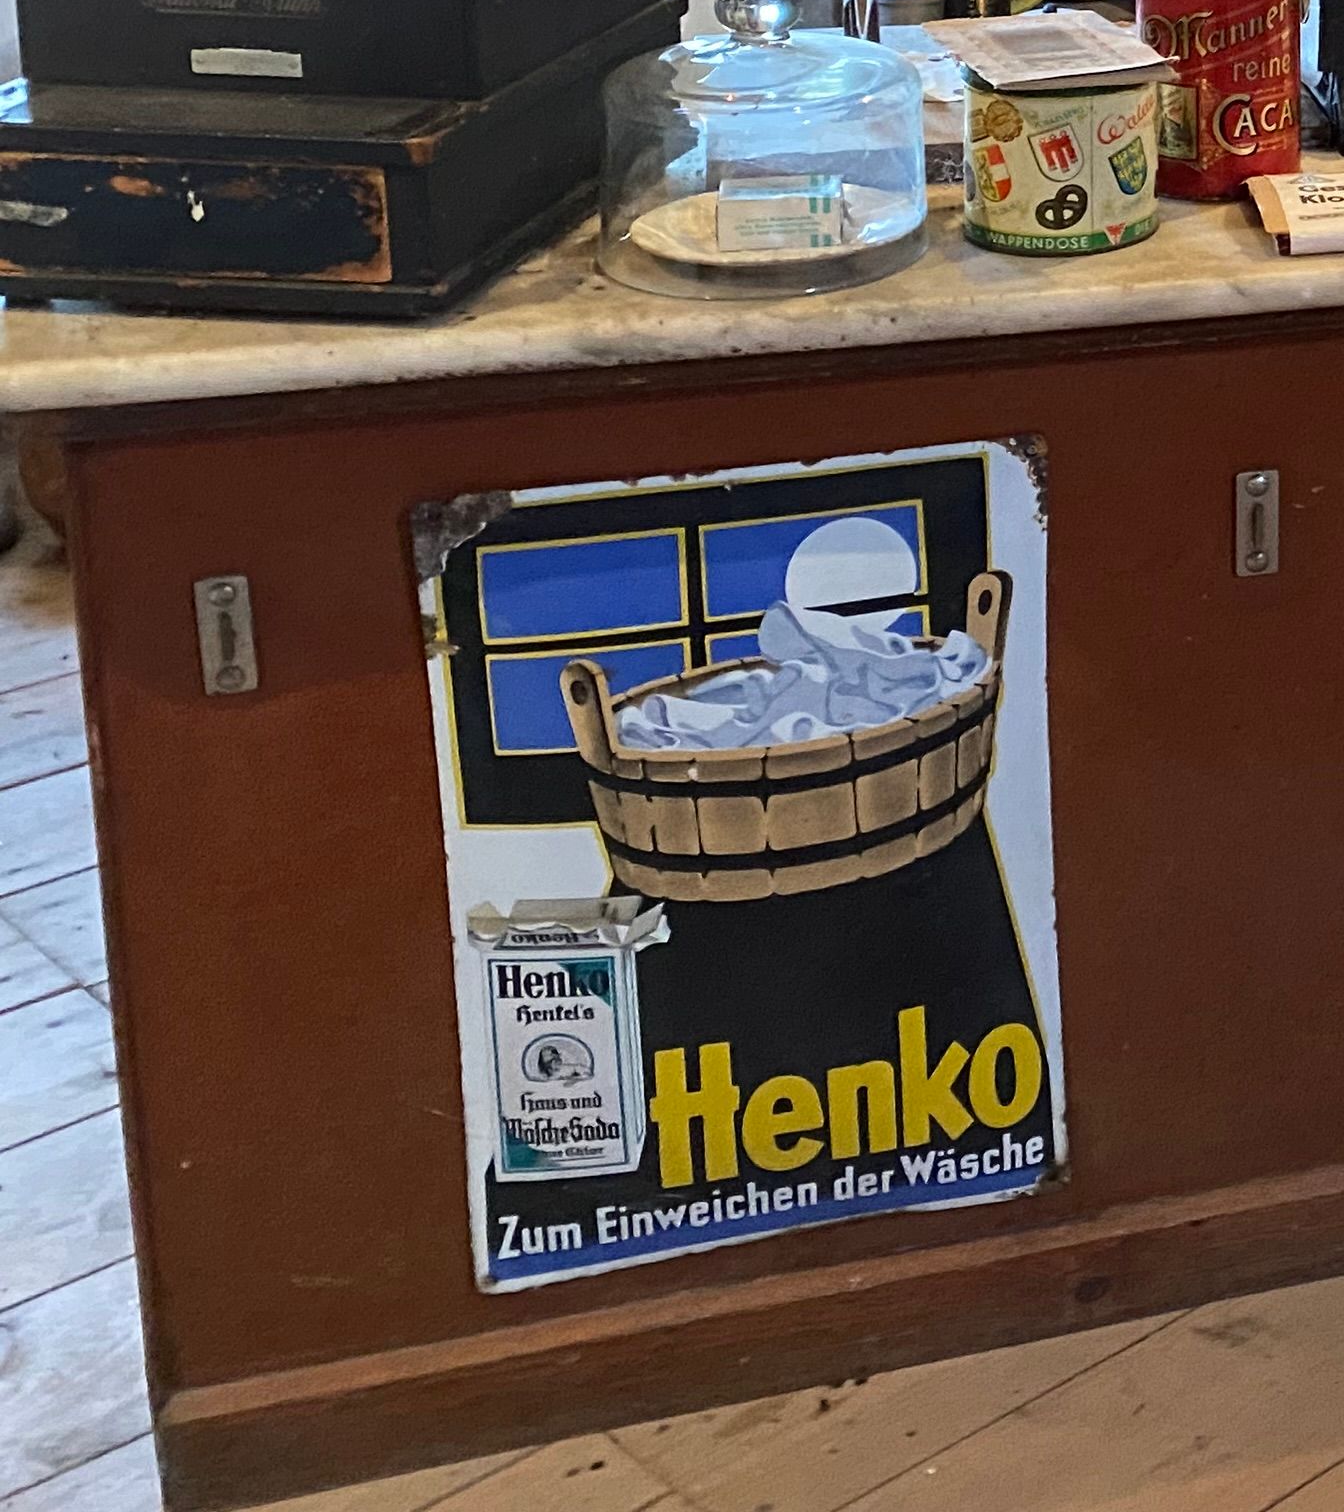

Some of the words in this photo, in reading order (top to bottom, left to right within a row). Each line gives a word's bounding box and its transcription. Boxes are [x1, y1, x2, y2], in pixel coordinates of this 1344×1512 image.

[988, 230, 1088, 250] WAPPENDOSE
[496, 963, 611, 999] Henko
[649, 1005, 1044, 1190] Henko
[497, 1215, 582, 1260] Zum
[597, 1181, 820, 1246] Einweichen
[833, 1164, 894, 1202] der
[900, 1133, 1045, 1187] Wäsche
